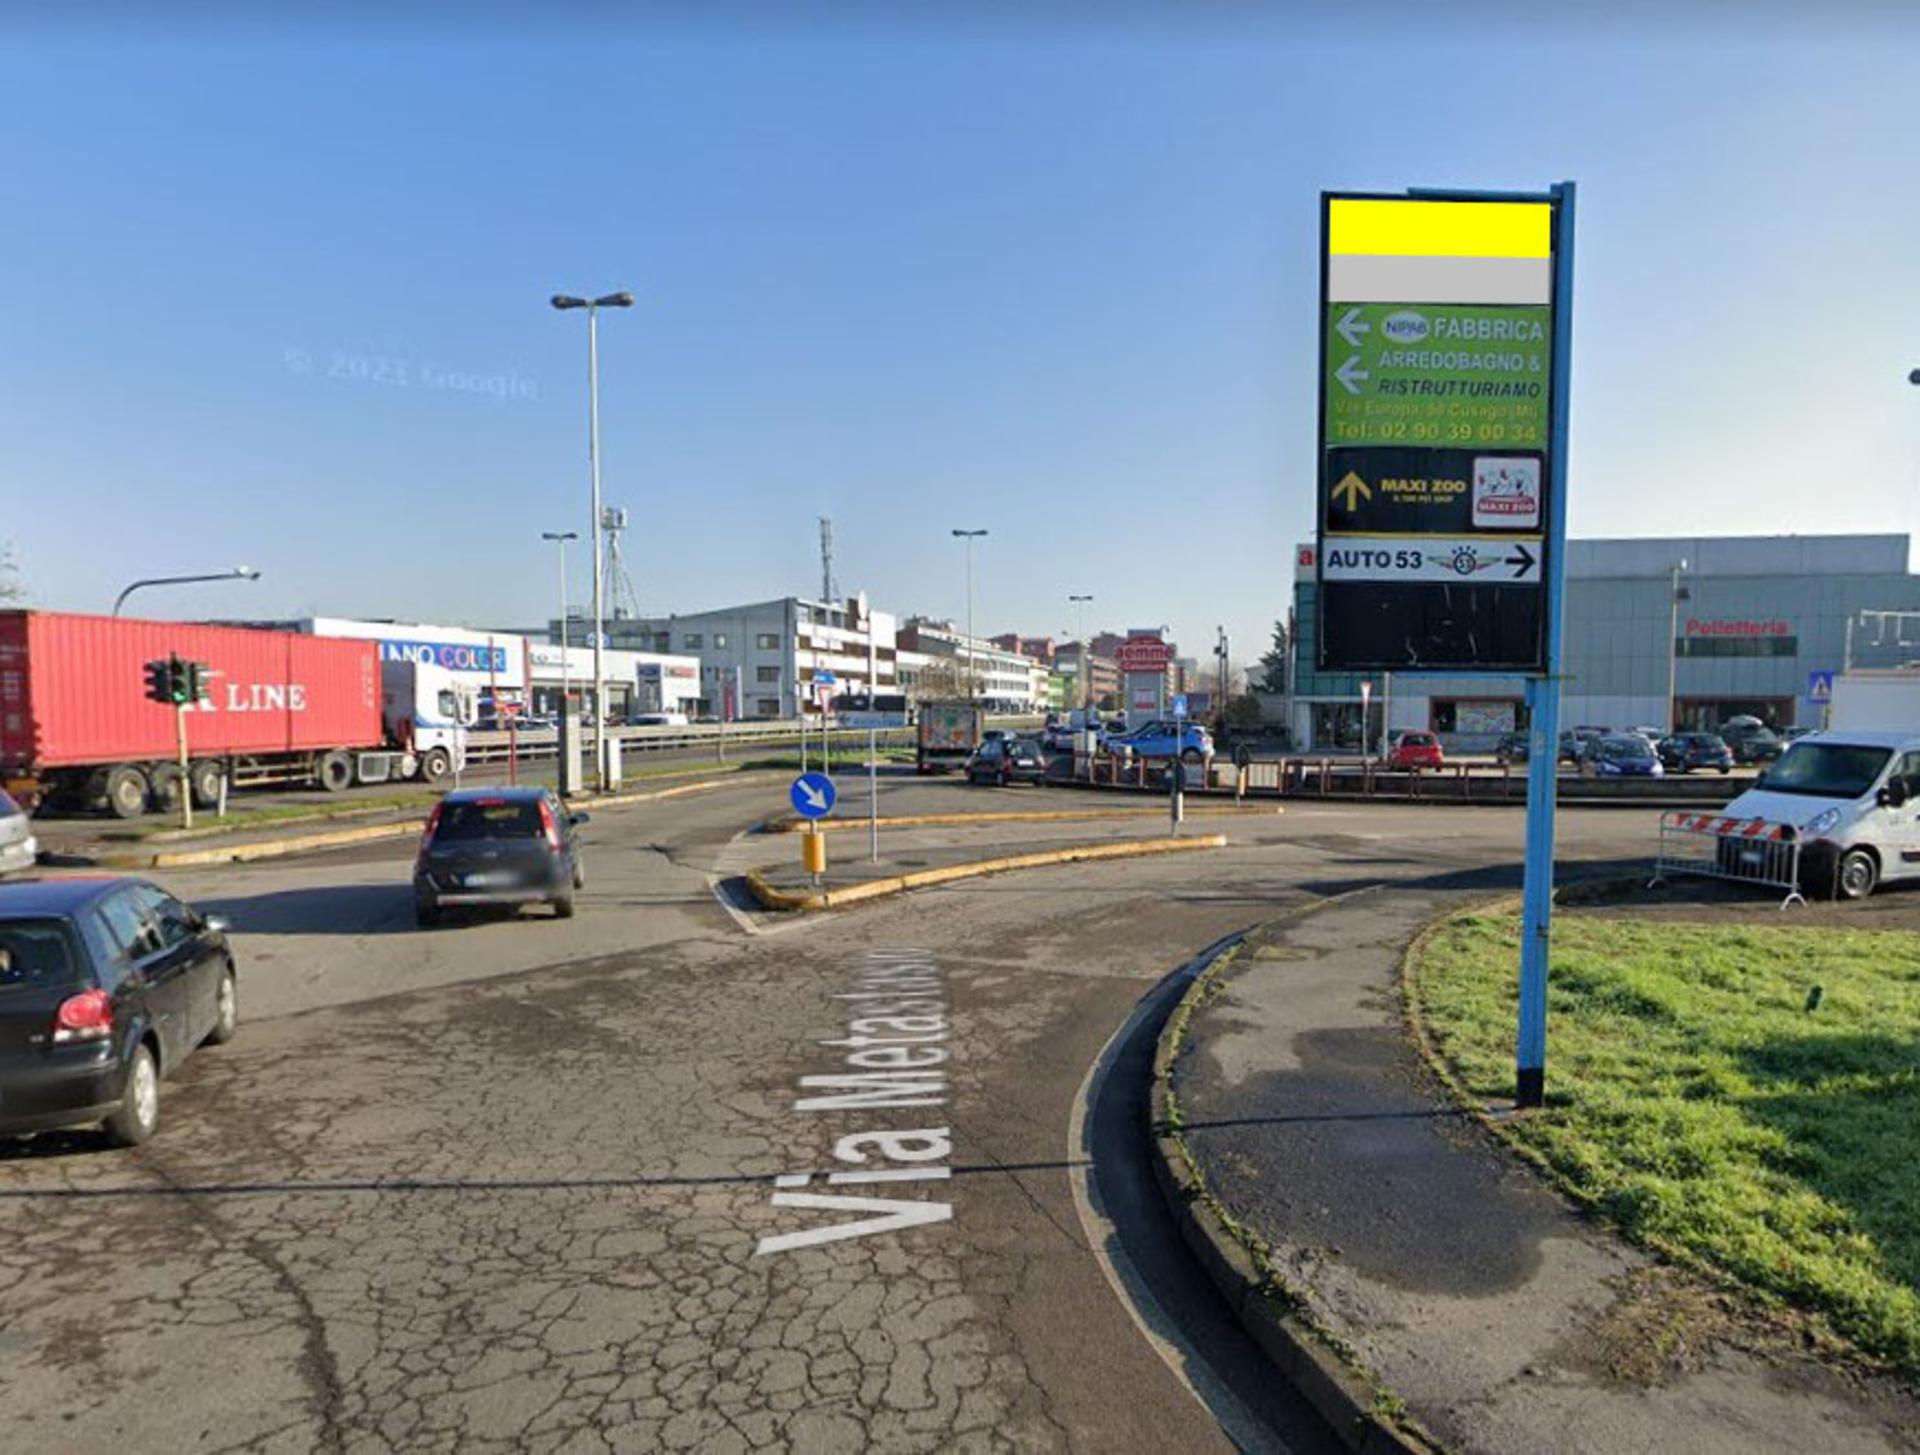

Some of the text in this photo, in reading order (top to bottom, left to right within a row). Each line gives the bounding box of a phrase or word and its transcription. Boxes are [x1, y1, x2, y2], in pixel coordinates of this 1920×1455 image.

[1434, 317, 1544, 341] FABBRICA
[1379, 351, 1541, 372] ARREDOBAGNO &
[1378, 378, 1541, 398] RISTRUTTURIAMO
[1380, 422, 1406, 438] 02
[1414, 422, 1439, 440] 90
[1448, 424, 1472, 440] 39
[1479, 424, 1504, 441] 00
[1381, 479, 1467, 493] MAXI ZOO
[1479, 502, 1534, 512] MAXI ZOO
[1327, 551, 1423, 569] AUTO 53
[440, 646, 506, 670] COLOR
[226, 684, 306, 711] LINE
